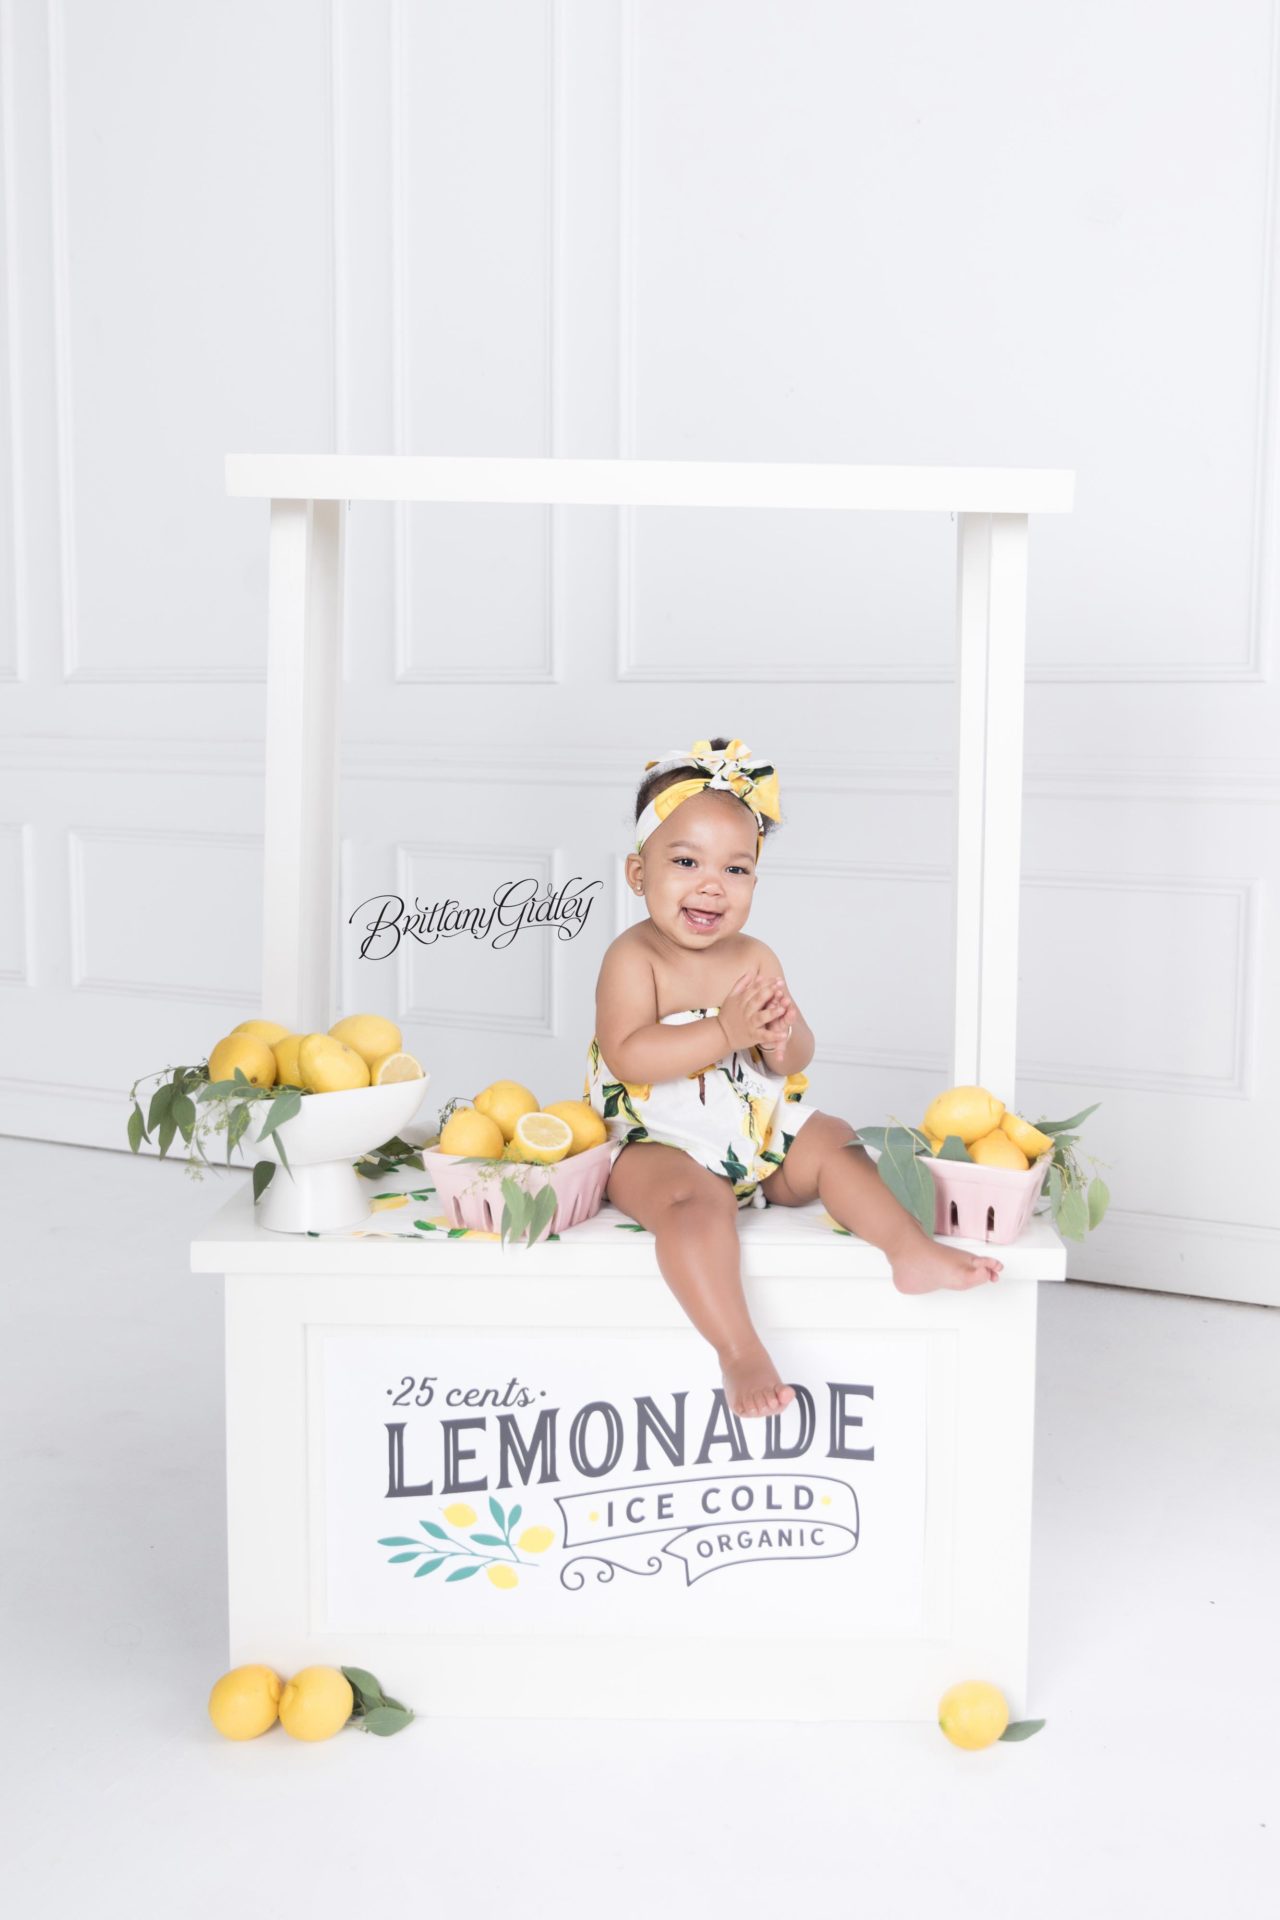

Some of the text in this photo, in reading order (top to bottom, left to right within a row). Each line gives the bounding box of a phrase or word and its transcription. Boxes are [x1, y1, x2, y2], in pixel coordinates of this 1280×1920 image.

[384, 1381, 876, 1498] LEMONADE
[606, 1485, 815, 1527] ICE COLD
[696, 1527, 826, 1559] ORGANIC
